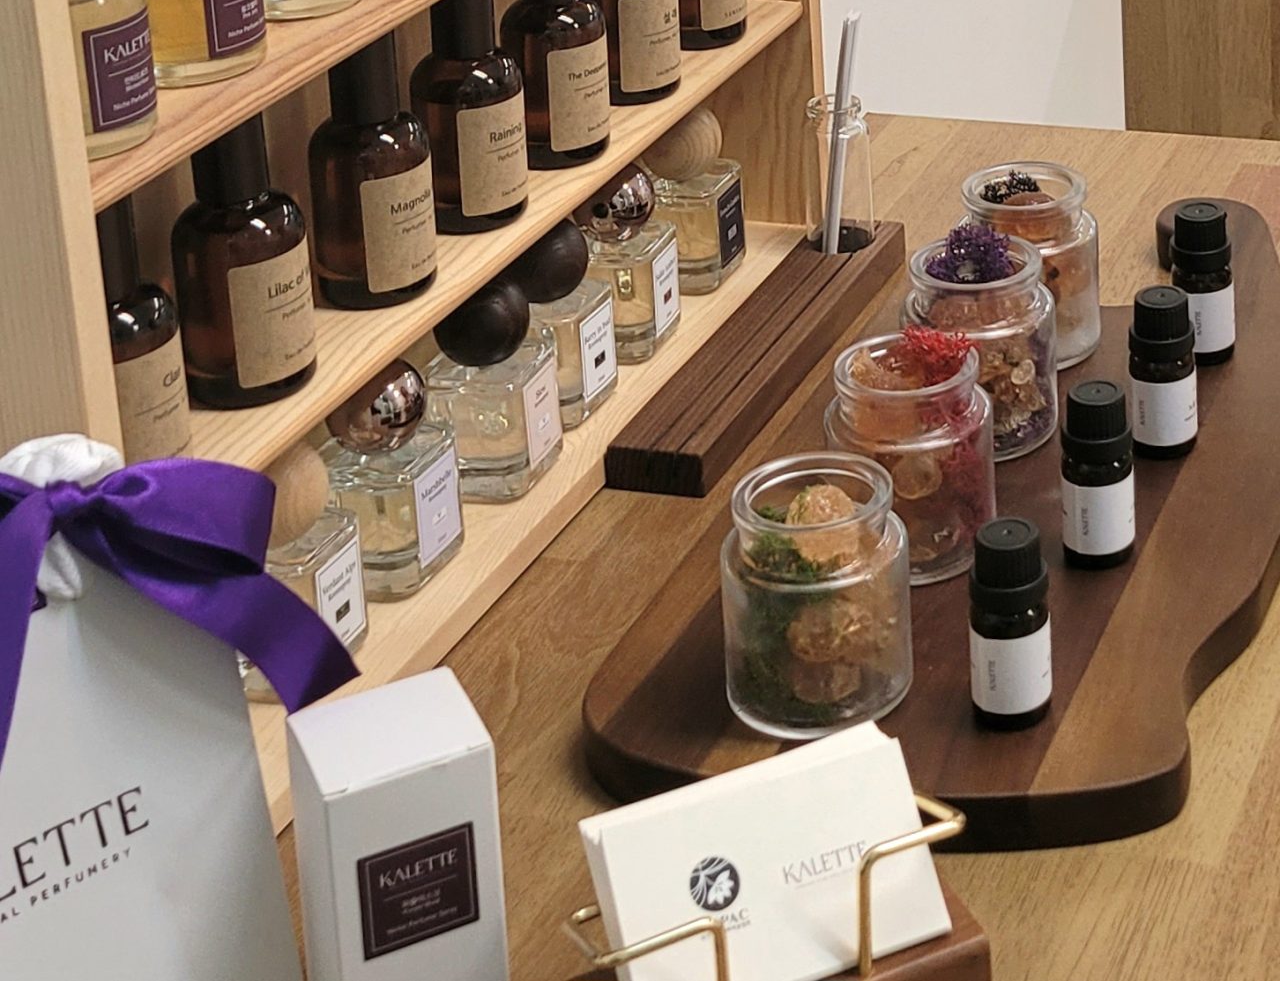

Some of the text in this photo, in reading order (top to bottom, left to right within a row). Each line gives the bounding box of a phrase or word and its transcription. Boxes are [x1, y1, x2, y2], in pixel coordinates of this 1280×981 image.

[568, 71, 582, 83] The
[267, 279, 295, 299] Lilac
[0, 785, 149, 902] ETTE
[781, 840, 867, 886] KALETTE
[30, 847, 131, 907] PERFUMERY
[379, 848, 458, 888] KALETTE
